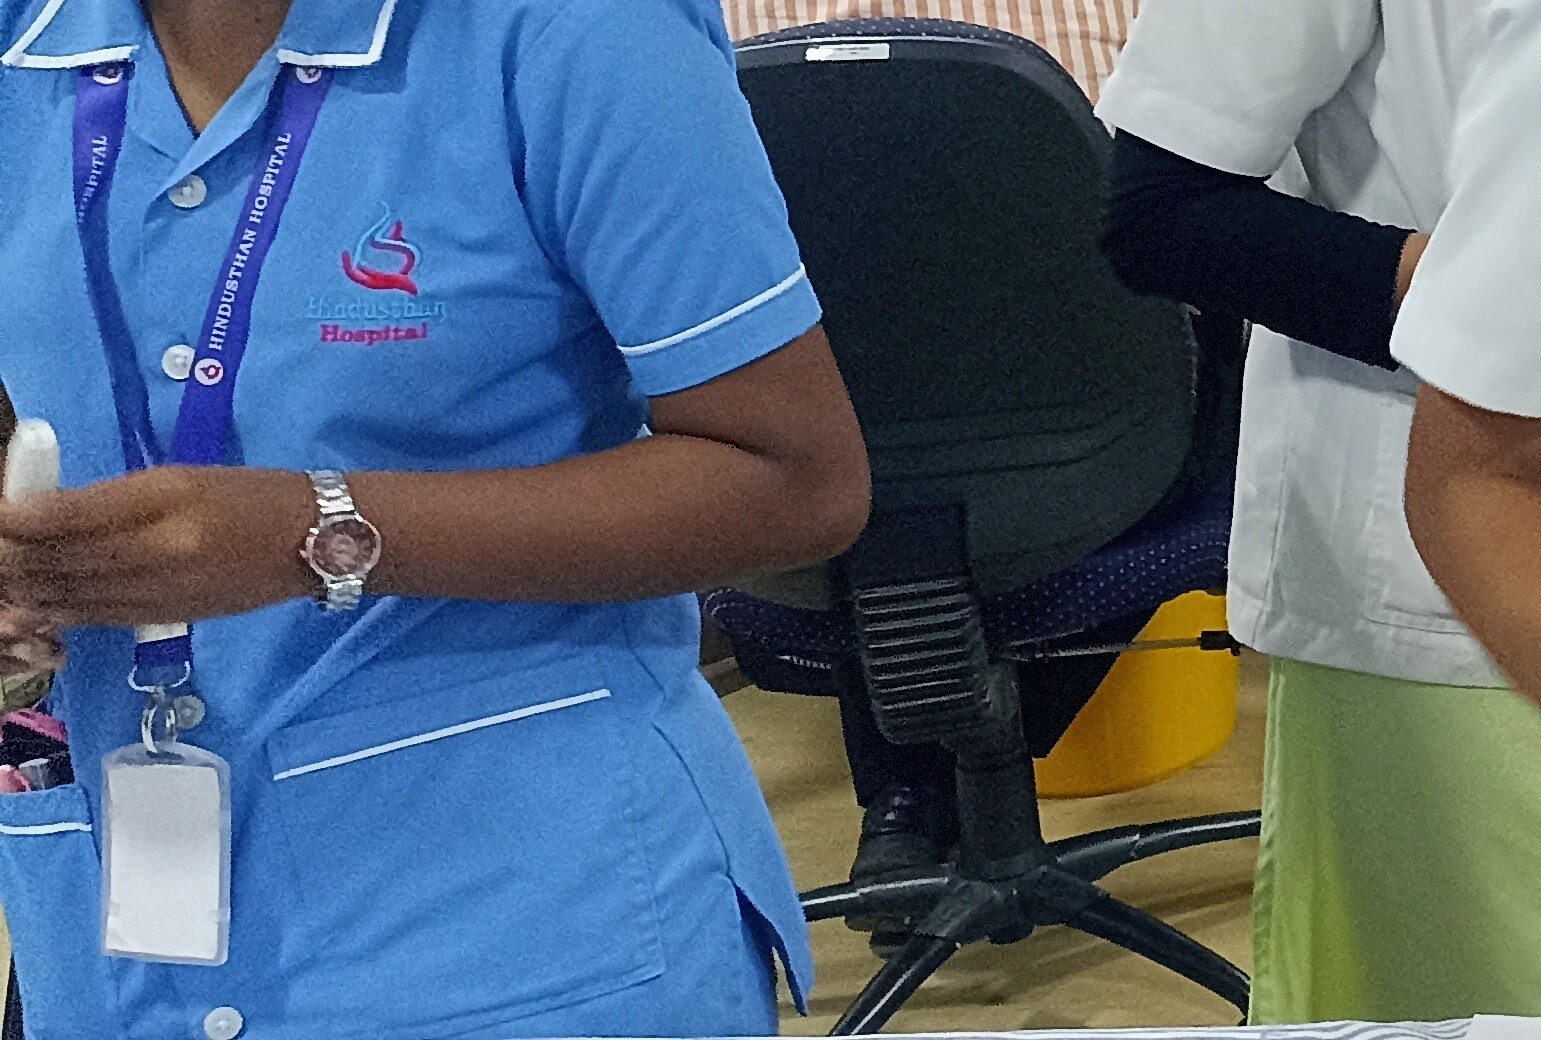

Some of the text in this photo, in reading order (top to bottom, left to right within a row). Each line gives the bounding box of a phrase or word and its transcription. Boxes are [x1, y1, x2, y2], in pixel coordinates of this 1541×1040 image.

[209, 132, 292, 351] HINDUSTHAN HOSPITAL
[320, 321, 427, 345] Hospital
